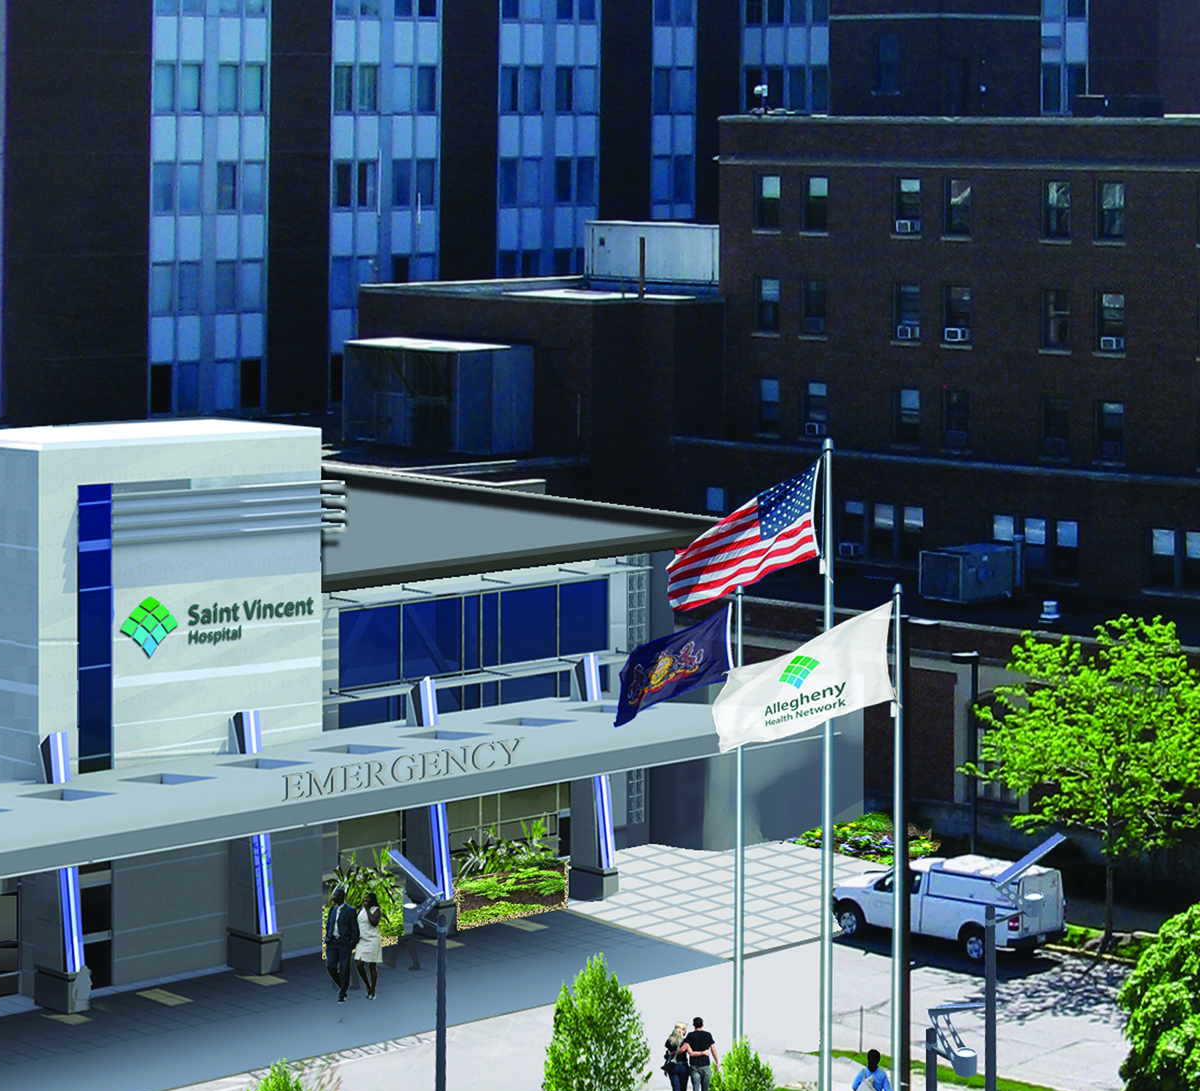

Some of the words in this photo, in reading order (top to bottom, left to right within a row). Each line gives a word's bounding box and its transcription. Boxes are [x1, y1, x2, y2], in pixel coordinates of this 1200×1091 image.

[188, 602, 241, 626] Saint
[243, 597, 314, 621] Vincent
[188, 625, 242, 646] Hospital
[764, 681, 847, 717] Allegheny
[765, 713, 794, 727] Health
[795, 698, 847, 719] Network
[282, 737, 525, 802] EMERGENCY
